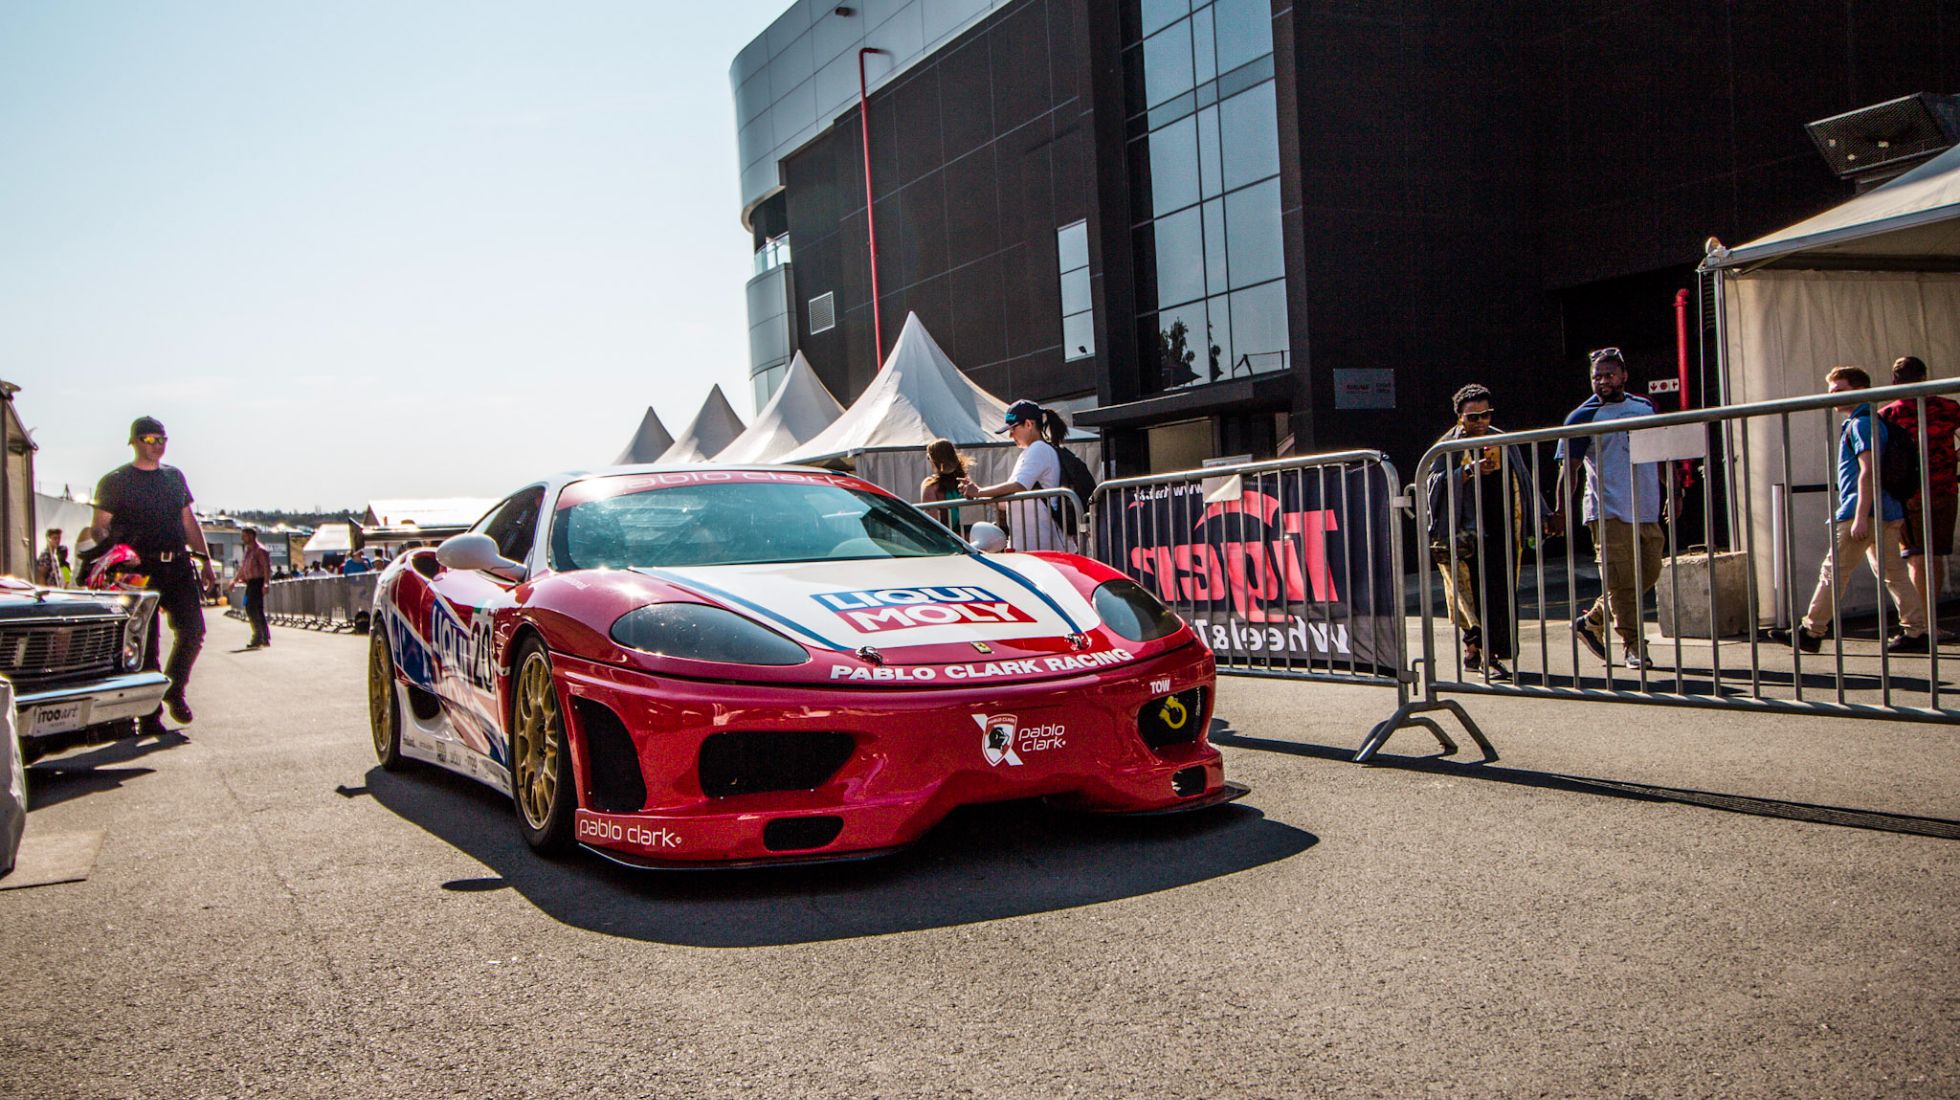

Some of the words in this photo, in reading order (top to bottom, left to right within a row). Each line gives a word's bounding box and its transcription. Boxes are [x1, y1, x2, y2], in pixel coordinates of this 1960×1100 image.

[820, 587, 997, 611] LIQUI
[847, 602, 1019, 632] MOLY
[471, 620, 492, 694] 20
[830, 664, 937, 681] PABLO
[944, 659, 1043, 679] CLARK
[1043, 648, 1134, 672] RACING
[1150, 679, 1171, 694] TOW
[1018, 723, 1066, 742] pablo
[579, 818, 623, 841] pablo
